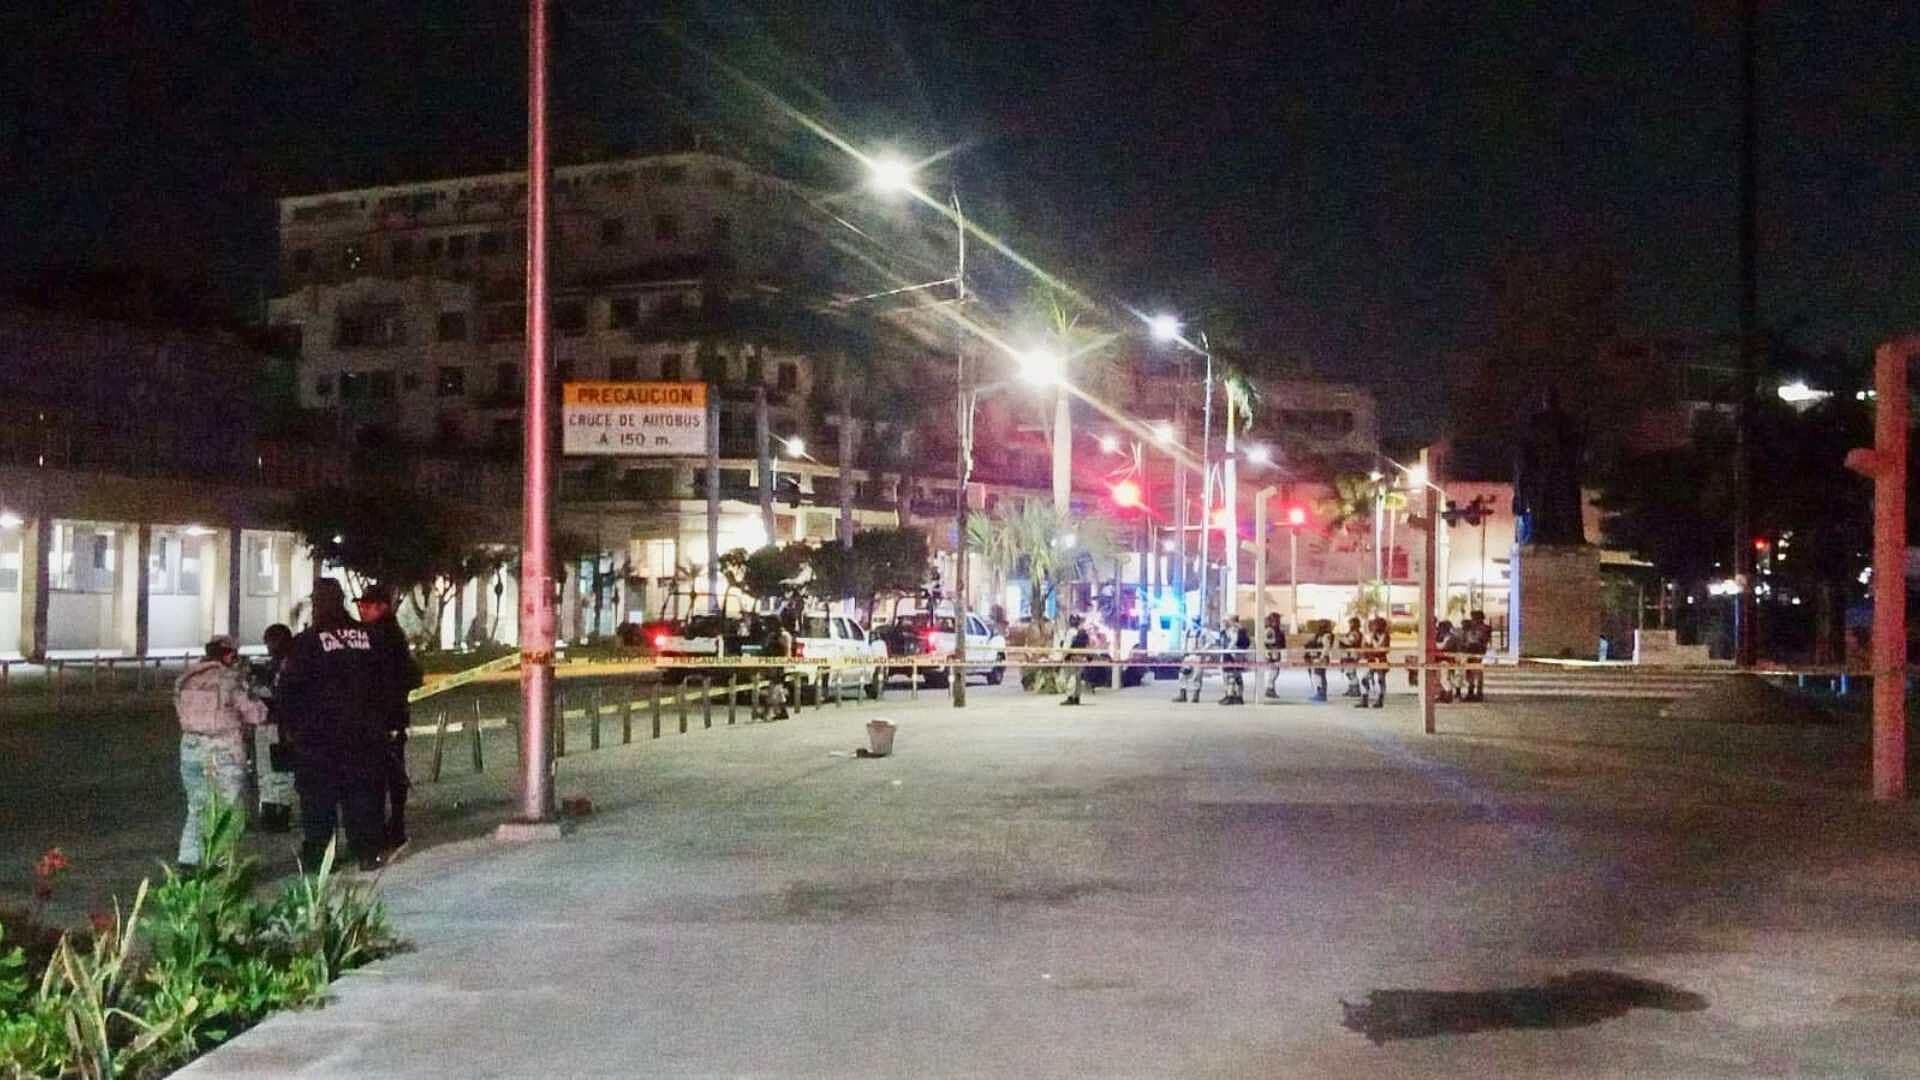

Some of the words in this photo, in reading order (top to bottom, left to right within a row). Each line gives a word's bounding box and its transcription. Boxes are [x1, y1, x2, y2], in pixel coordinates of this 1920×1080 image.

[577, 388, 693, 403] PRECAUCION
[569, 414, 611, 426] CRUCE
[619, 414, 634, 426] DE
[643, 414, 700, 426] AUTOBUS
[599, 433, 609, 445] A
[620, 433, 646, 446] 150
